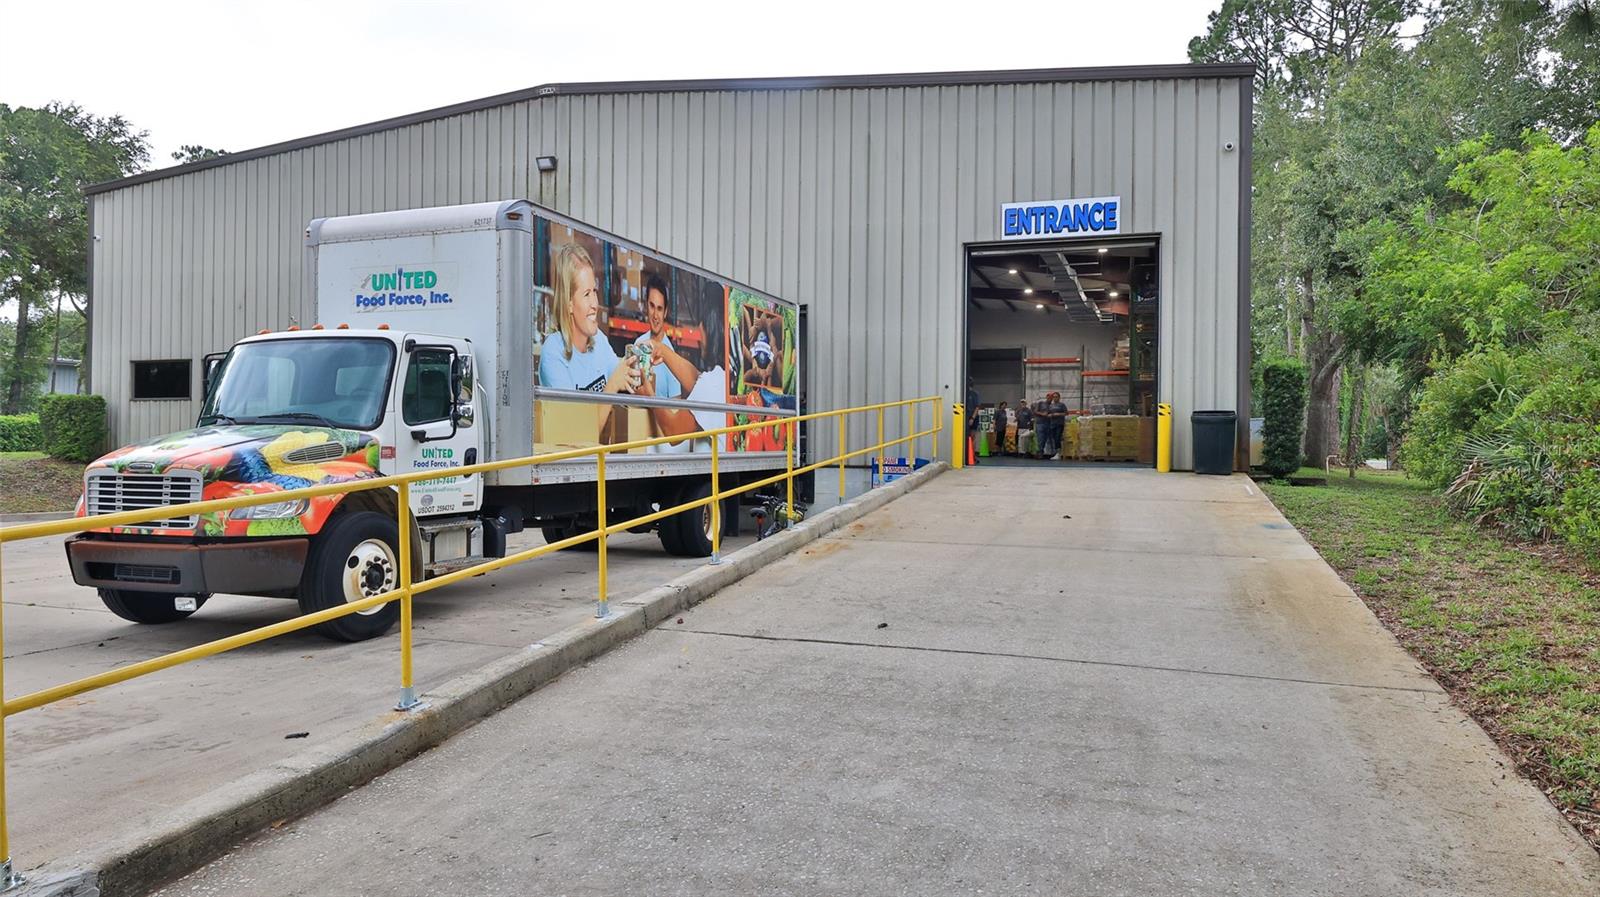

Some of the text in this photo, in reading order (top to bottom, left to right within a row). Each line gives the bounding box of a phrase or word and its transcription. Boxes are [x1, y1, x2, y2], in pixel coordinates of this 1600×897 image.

[1004, 202, 1117, 236] ENTRANCE
[371, 268, 437, 291] UNITED
[356, 291, 453, 307] Food Force, Inc.
[422, 447, 453, 458] UNITED
[431, 460, 448, 468] Force,
[418, 505, 435, 514] USDOT
